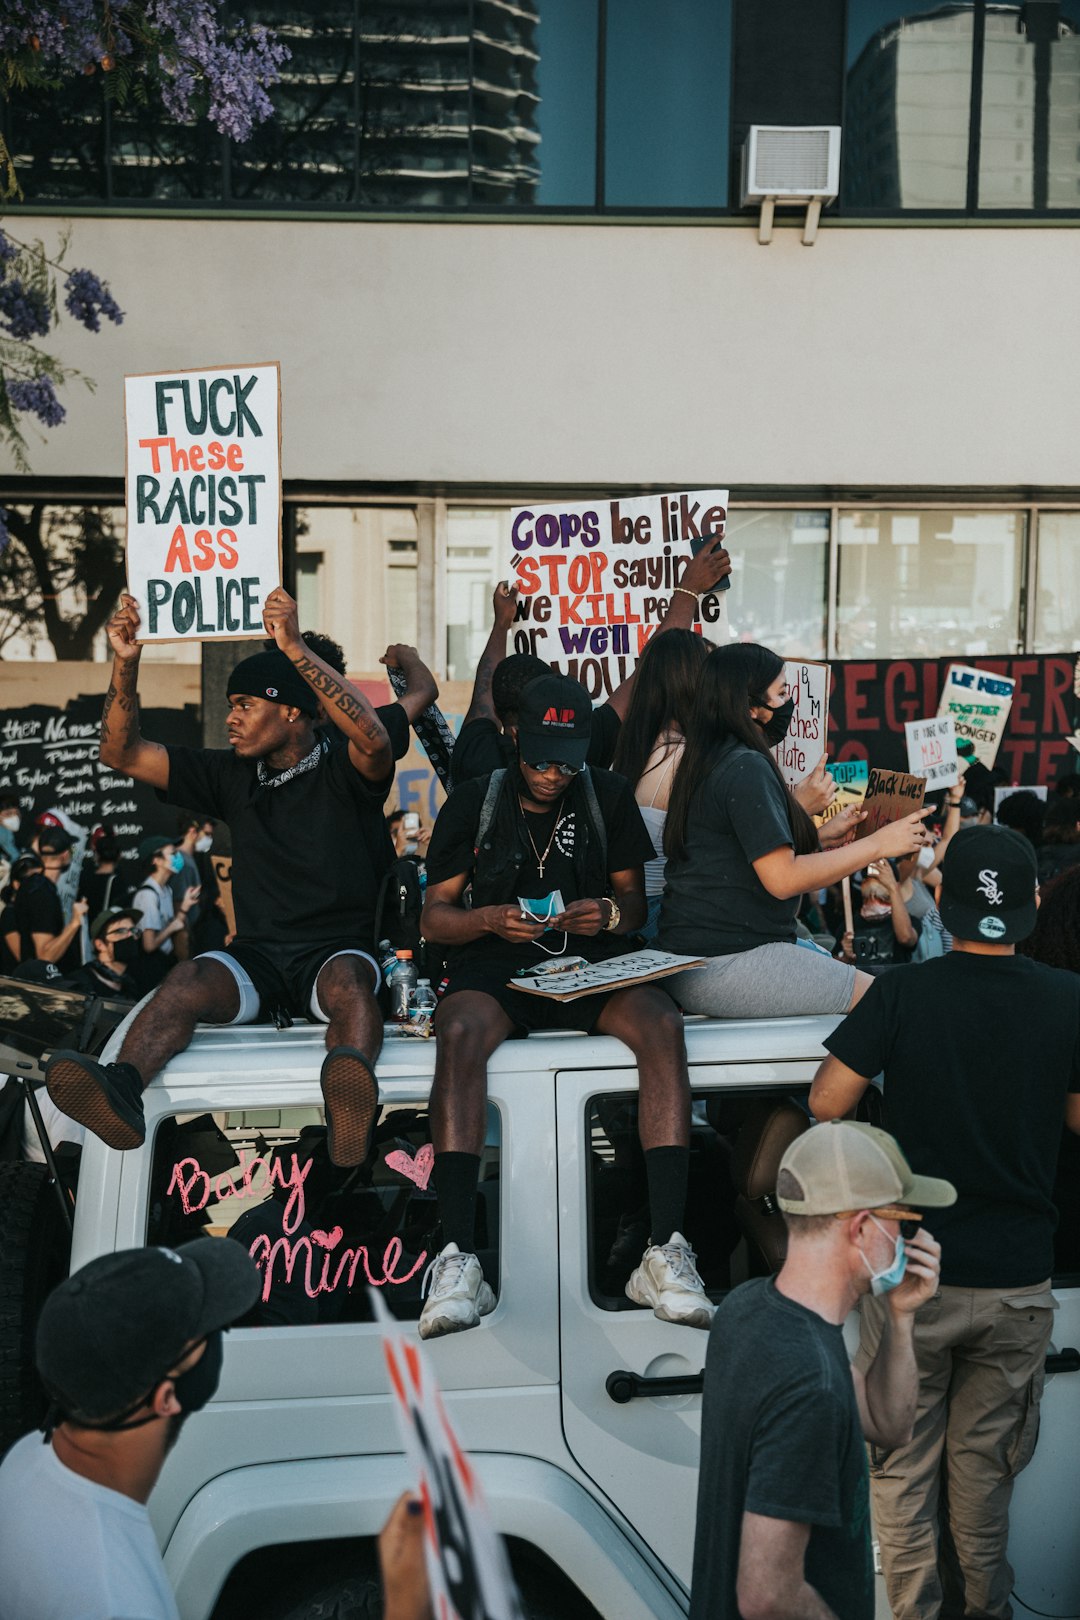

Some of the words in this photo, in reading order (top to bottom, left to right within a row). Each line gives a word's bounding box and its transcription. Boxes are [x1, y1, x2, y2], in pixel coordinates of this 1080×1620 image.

[155, 375, 263, 437] FUCK
[139, 437, 244, 473] These
[137, 475, 265, 526] RACIST
[610, 501, 651, 544] be
[661, 495, 726, 543] like
[164, 525, 238, 573] ASS
[147, 577, 263, 634] POLICE
[559, 593, 641, 626] KILL
[558, 623, 630, 655] we'll
[828, 658, 1074, 734] EGIER
[948, 702, 1000, 717] TOGETHER
[865, 770, 898, 799] Black
[899, 775, 923, 799] Lives
[166, 1150, 314, 1236] Baby
